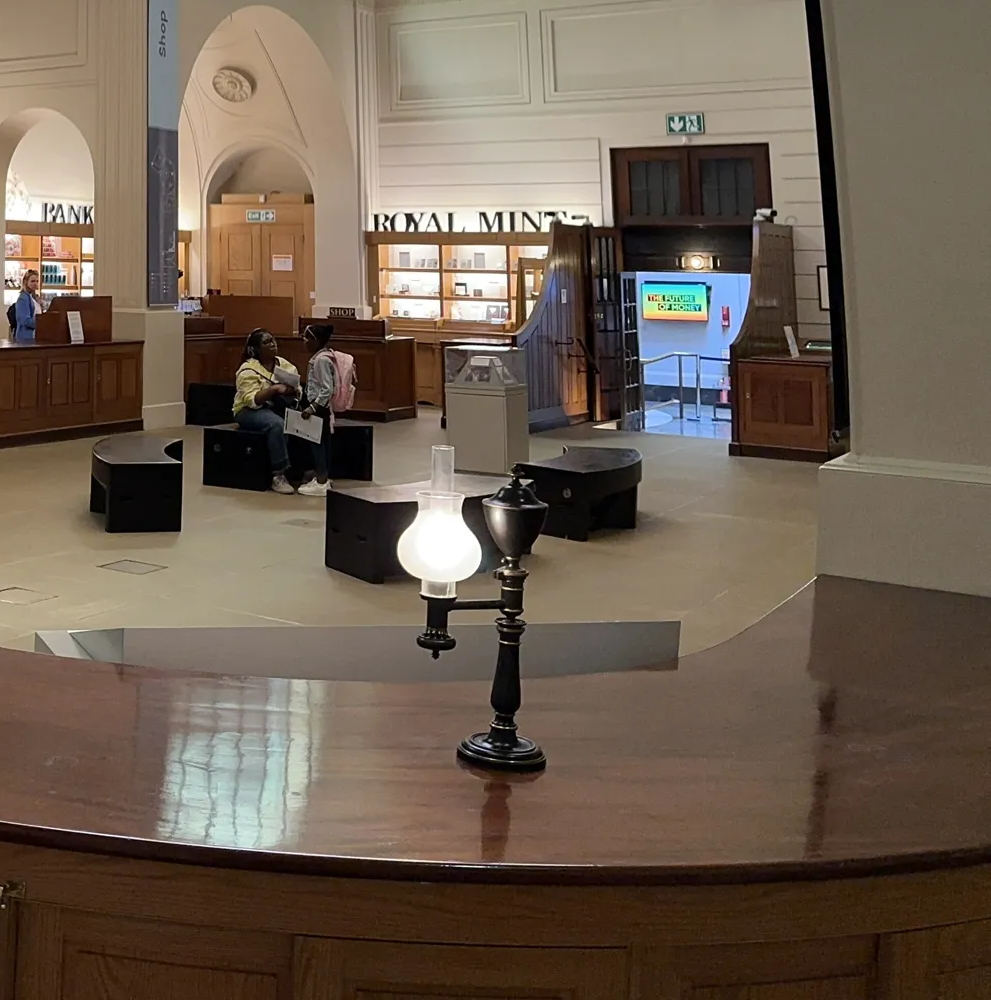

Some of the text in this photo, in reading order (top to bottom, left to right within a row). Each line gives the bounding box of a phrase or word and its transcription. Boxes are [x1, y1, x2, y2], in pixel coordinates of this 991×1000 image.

[159, 10, 168, 57] Shop
[42, 202, 94, 223] BANK
[372, 212, 466, 232] ROYAL
[665, 295, 695, 303] FUTURE
[330, 308, 354, 316] SHOP
[672, 304, 701, 312] MONEY
